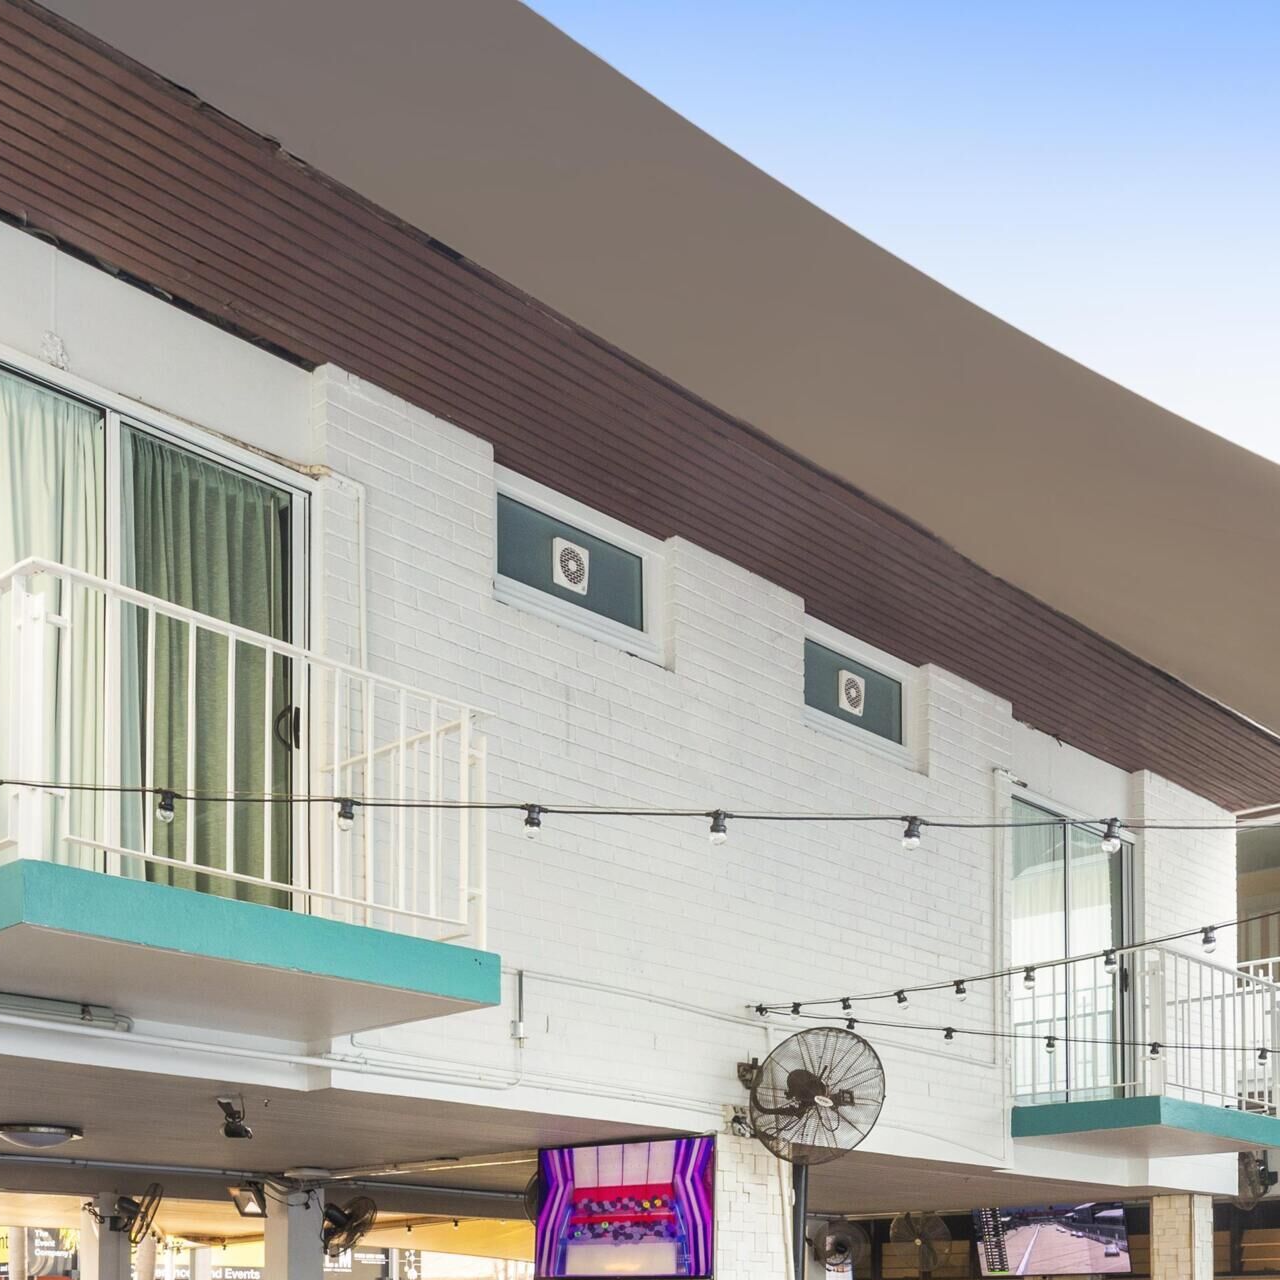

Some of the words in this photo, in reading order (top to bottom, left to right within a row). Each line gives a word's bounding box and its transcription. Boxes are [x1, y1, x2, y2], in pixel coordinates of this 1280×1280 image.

[34, 1229, 49, 1237] The
[34, 1238, 56, 1247] Event
[224, 1268, 260, 1280] Events
